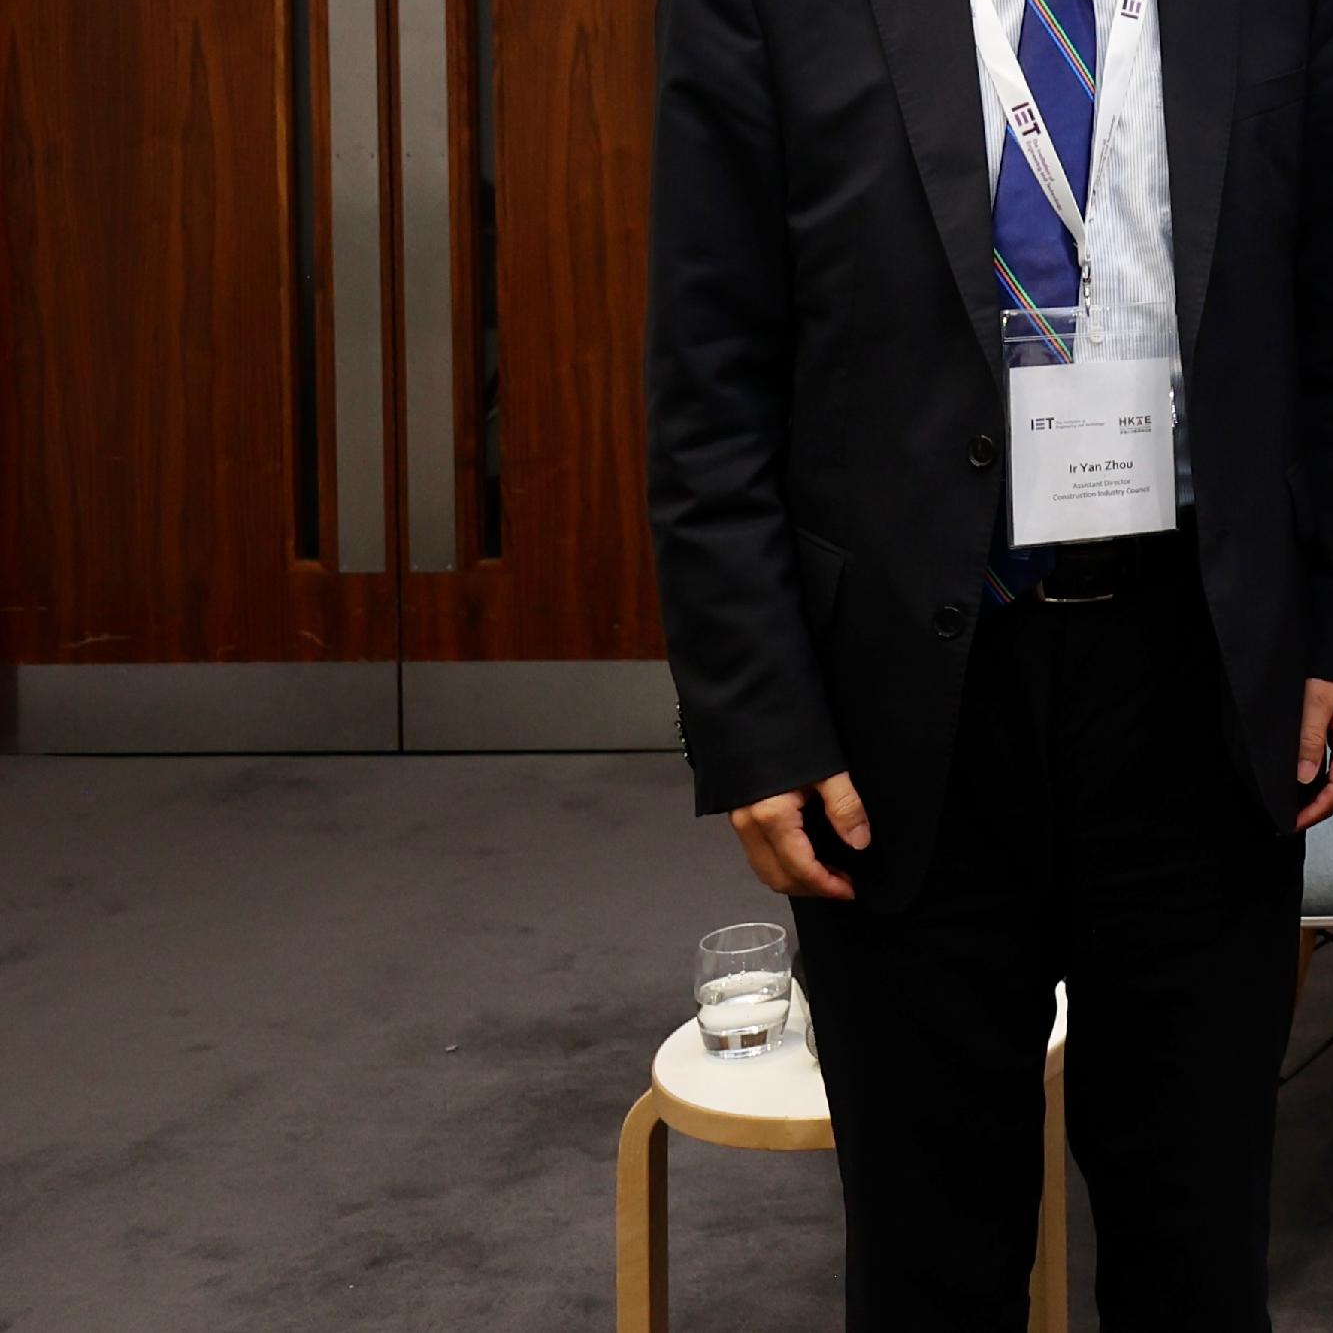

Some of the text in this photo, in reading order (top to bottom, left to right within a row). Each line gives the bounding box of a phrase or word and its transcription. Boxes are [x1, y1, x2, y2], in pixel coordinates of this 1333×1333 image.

[1012, 102, 1041, 136] IET
[1031, 417, 1054, 431] IET
[1069, 460, 1133, 473] Ir Yan Zhou
[1073, 478, 1131, 489] Assistant Director
[1053, 491, 1096, 501] Construction
[1097, 488, 1124, 498] Industry
